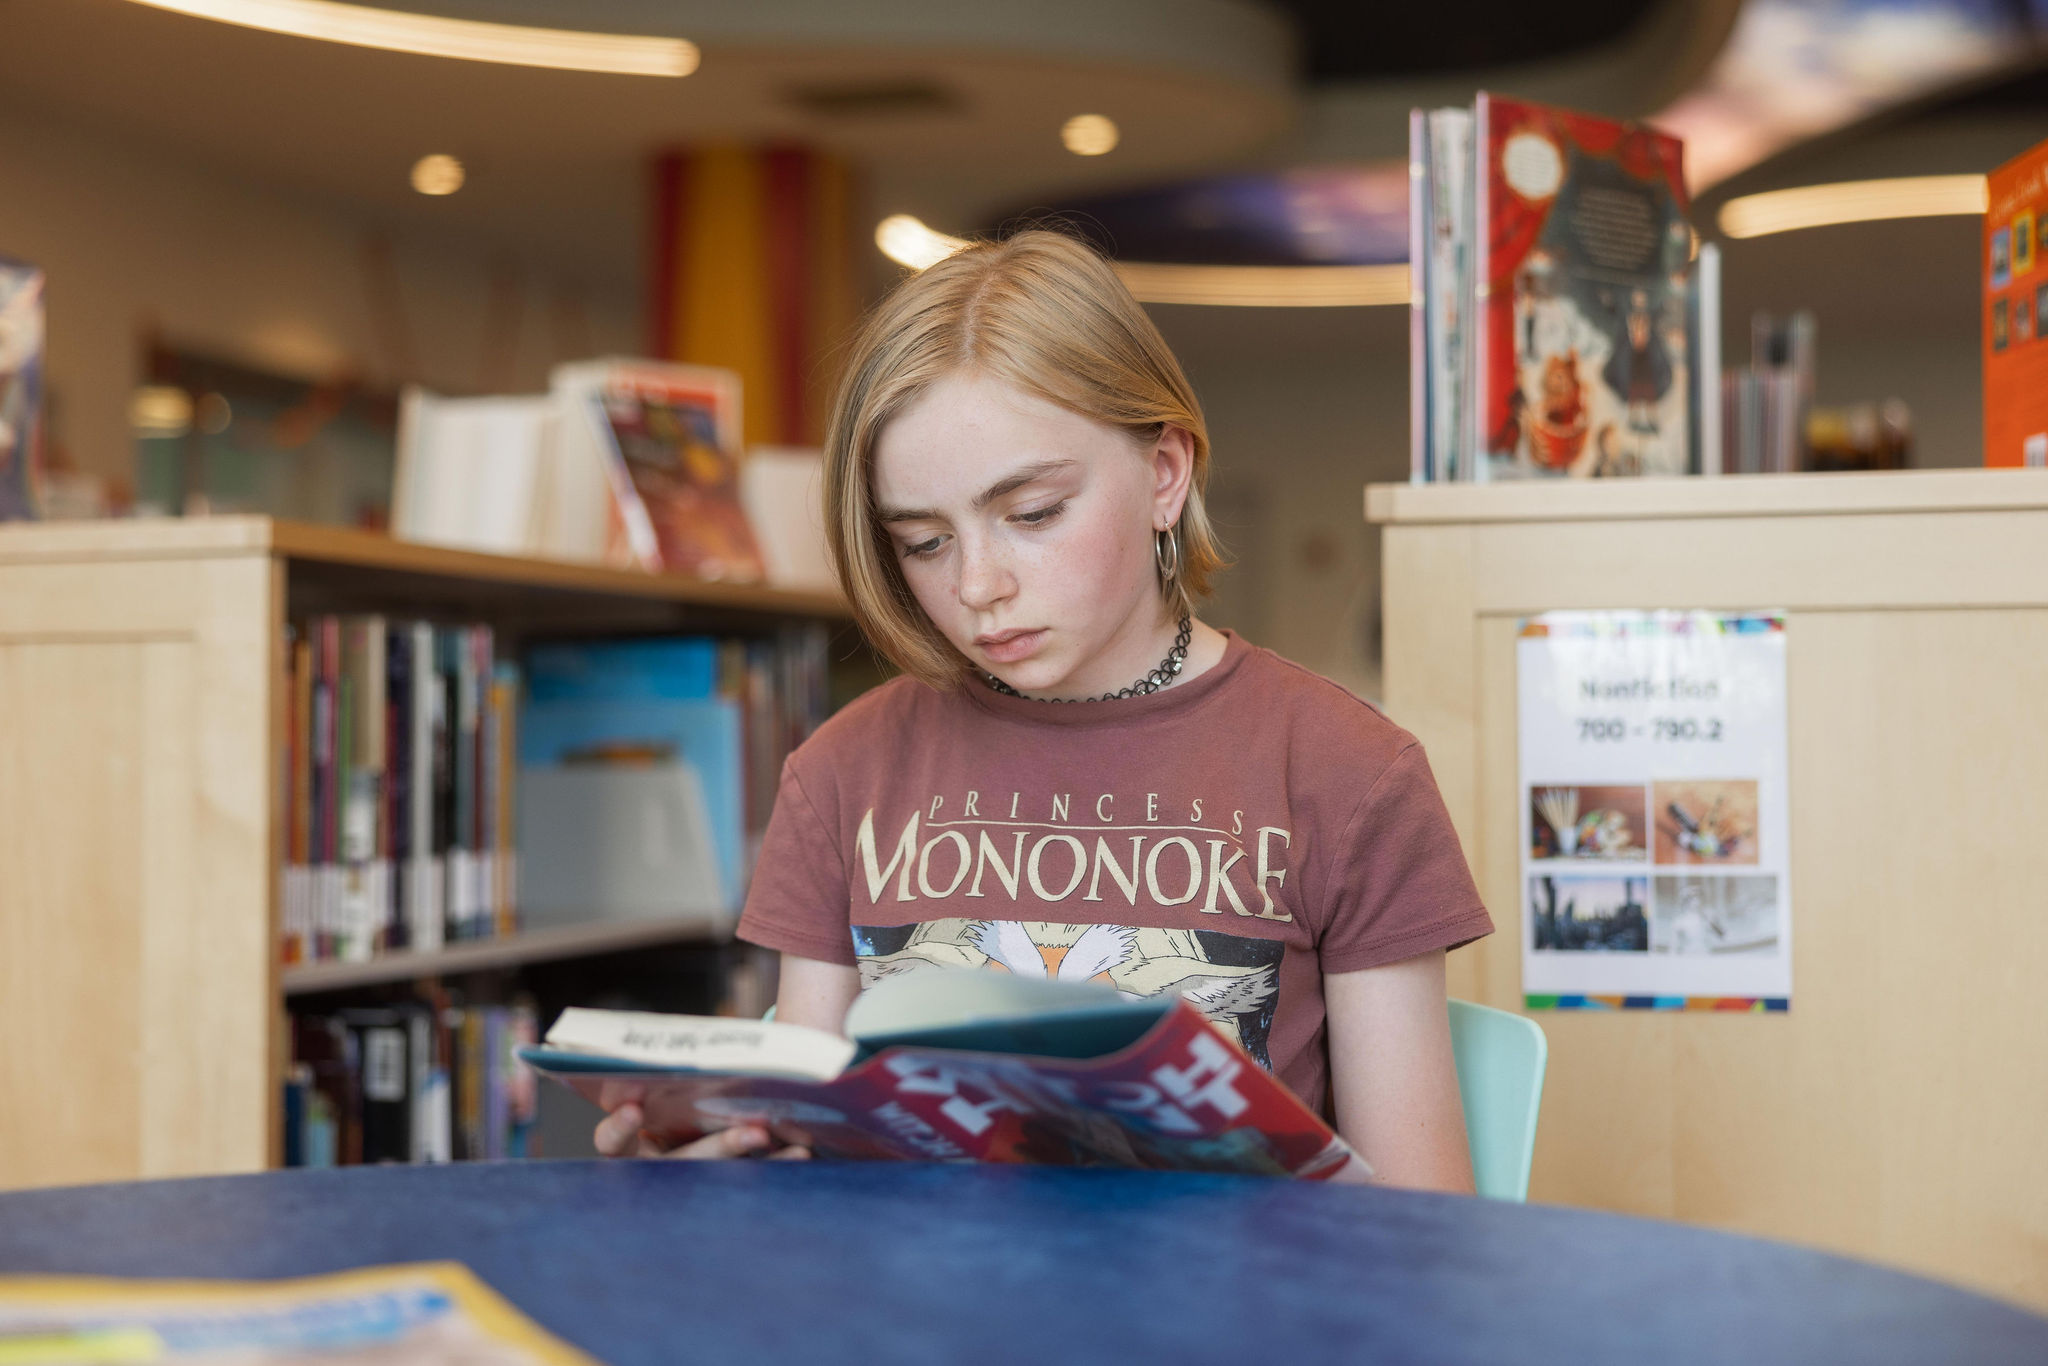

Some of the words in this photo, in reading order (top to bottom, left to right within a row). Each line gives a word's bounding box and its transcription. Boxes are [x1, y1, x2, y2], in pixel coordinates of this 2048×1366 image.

[1576, 717, 1625, 743] 700
[1652, 717, 1723, 743] 790.2
[927, 790, 1244, 836] PRINCESS
[856, 807, 1294, 924] MONONOKE
